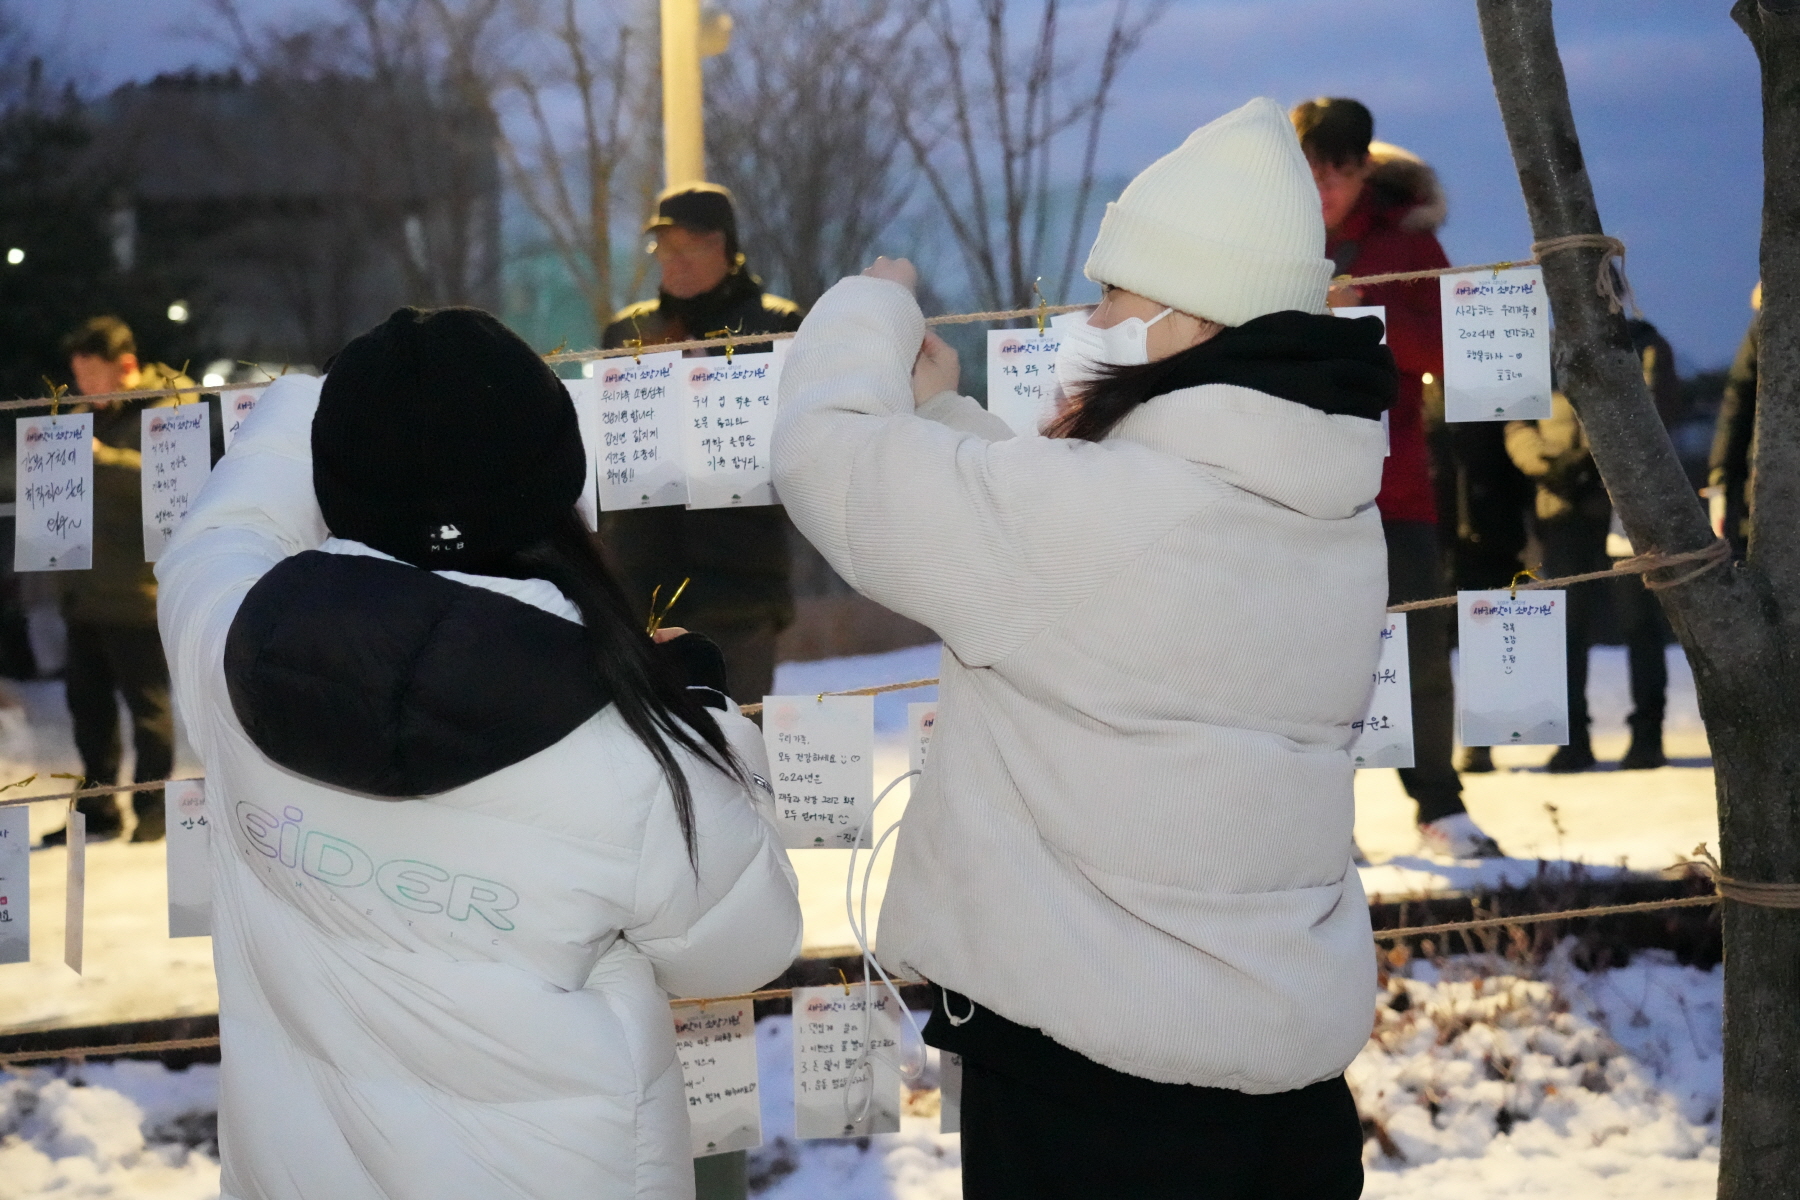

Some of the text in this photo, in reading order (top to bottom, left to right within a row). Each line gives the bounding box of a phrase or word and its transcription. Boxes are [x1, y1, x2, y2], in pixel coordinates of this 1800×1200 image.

[1455, 285, 1494, 296] 새해맞이
[1497, 283, 1533, 296] 소망기원
[1455, 304, 1494, 317] 사랑하는
[1459, 328, 1536, 339] 2024년 건강하고
[1002, 342, 1061, 354] 새해맞이 소망
[1466, 349, 1504, 363] 행복하자
[605, 371, 637, 383] 새해맞이
[640, 366, 671, 380] 소망기원
[692, 371, 728, 383] 새해맞이
[731, 367, 766, 381] 소망기원
[1002, 364, 1019, 378] 가족
[1024, 363, 1040, 377] 모두
[151, 420, 175, 433] 새해맞이
[178, 417, 201, 430] 소망기원
[27, 431, 53, 442] 새해맞이
[56, 428, 83, 441] 소망기원
[431, 541, 465, 552] MLB
[1473, 604, 1552, 616] 새해맞이 소망기원
[778, 752, 837, 764] 모두 건강하세요
[779, 772, 823, 785] 2024년은
[807, 1002, 846, 1013] 새해맞이
[675, 1016, 740, 1034] 해맞이 소망기원
